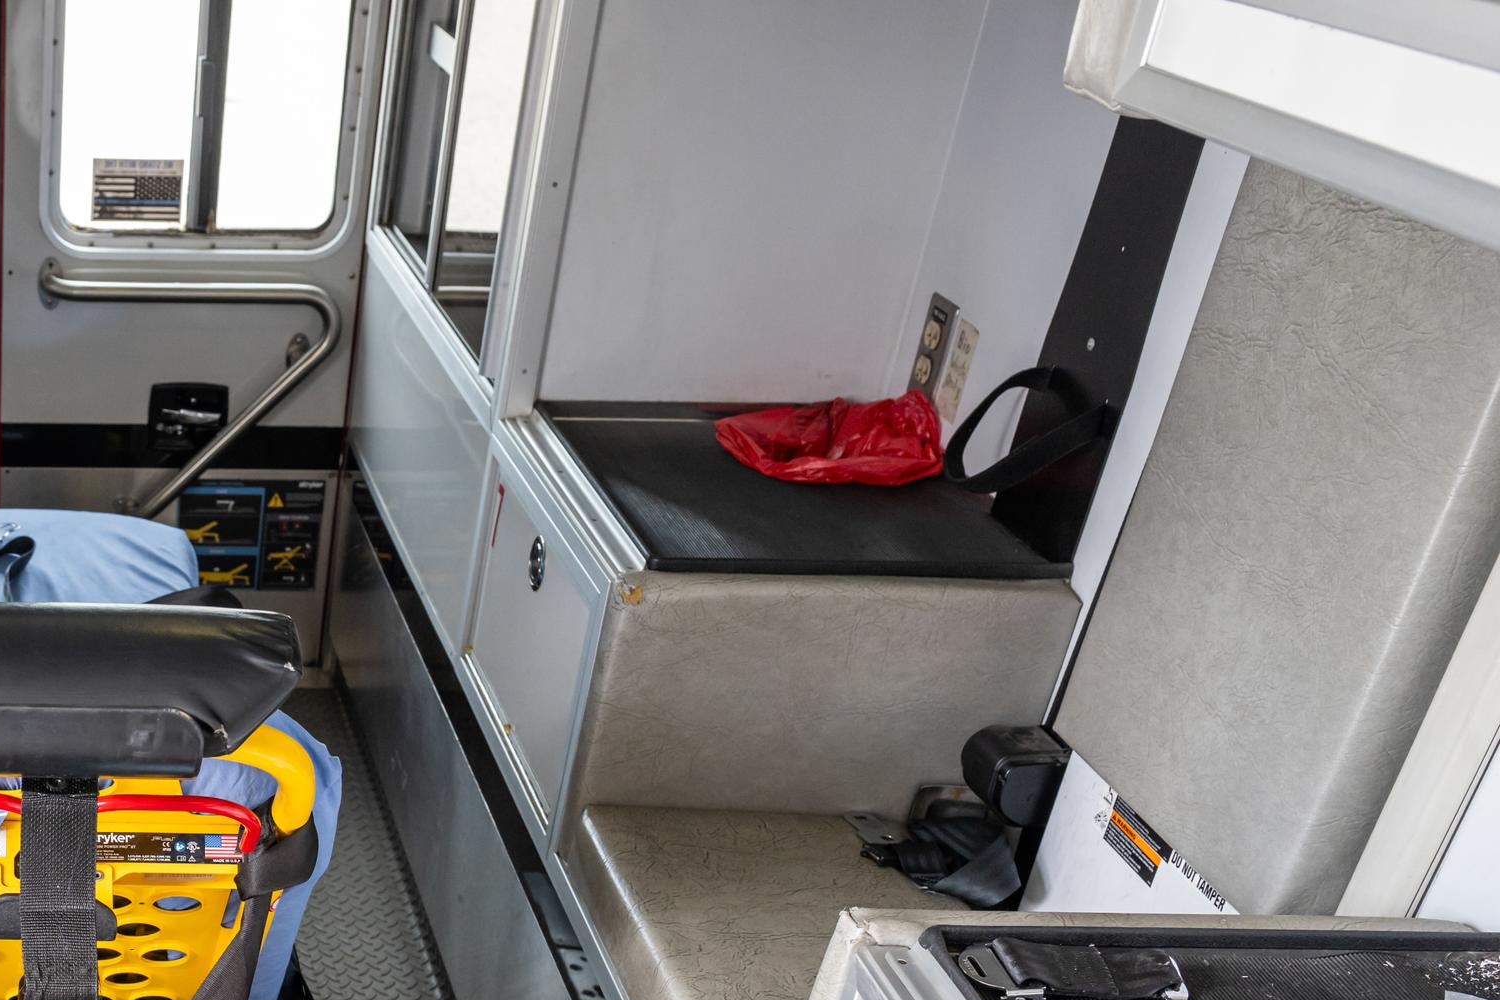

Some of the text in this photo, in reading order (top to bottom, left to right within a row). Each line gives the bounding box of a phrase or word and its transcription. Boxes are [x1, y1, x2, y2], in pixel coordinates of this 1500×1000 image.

[97, 833, 133, 844] ryker
[1116, 819, 1136, 840] WARNING
[1171, 851, 1226, 912] DO NOT TAMPER
